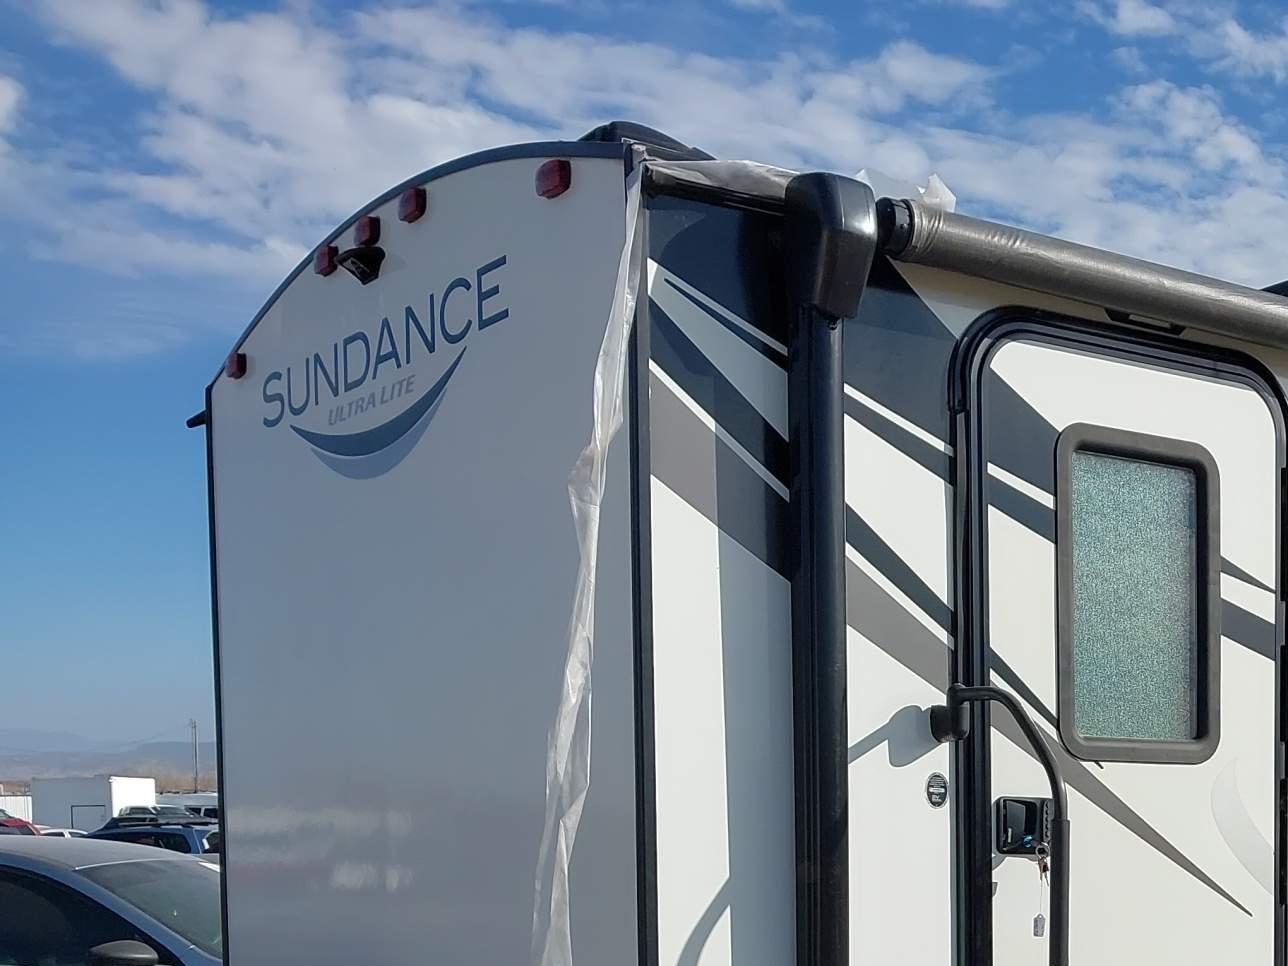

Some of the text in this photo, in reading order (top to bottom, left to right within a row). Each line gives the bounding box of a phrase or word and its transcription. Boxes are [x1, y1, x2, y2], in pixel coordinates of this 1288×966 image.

[262, 254, 510, 428] SUNDANCE
[327, 373, 417, 427] ULTRA LITE
